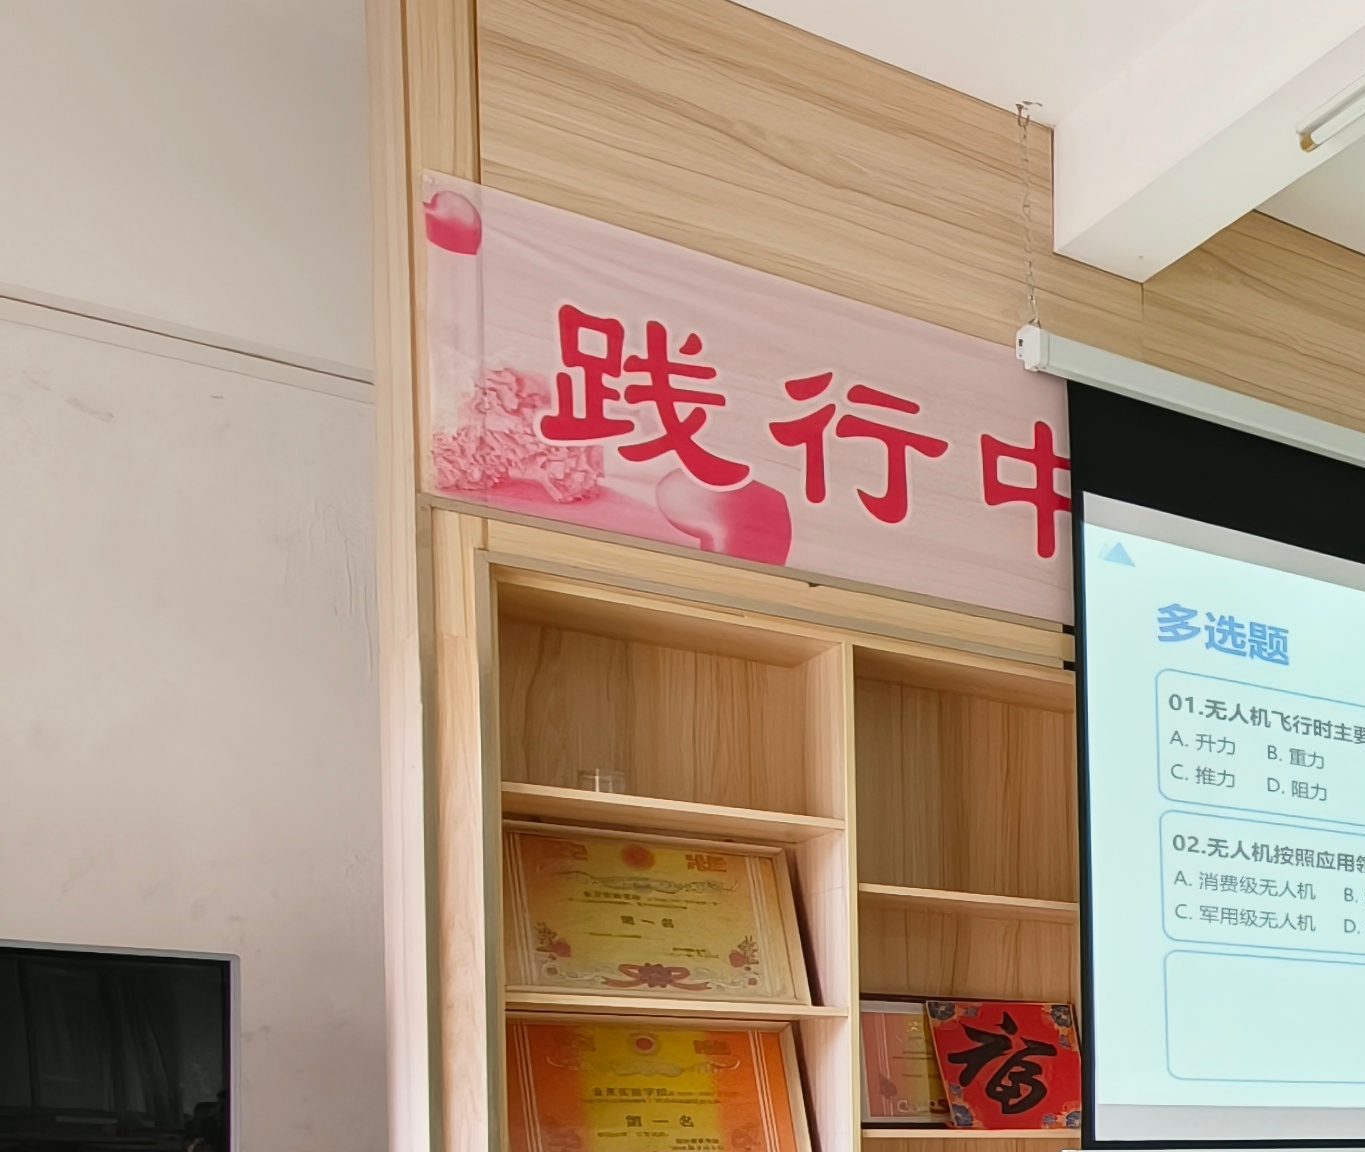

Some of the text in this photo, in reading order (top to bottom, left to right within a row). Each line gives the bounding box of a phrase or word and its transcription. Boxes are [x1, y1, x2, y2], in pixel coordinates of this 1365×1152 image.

[538, 303, 1071, 559] 践行中
[1157, 603, 1290, 665] 多选题
[1169, 730, 1326, 770] A. 升力 B. 重力
[1170, 763, 1328, 801] C. 推力 D. 阻力
[1173, 870, 1193, 887] A.
[1199, 872, 1317, 901] 消费级无人机
[1343, 887, 1359, 904] B.
[1174, 903, 1193, 921] C.
[1199, 904, 1317, 932] 军用级无人机
[1343, 919, 1361, 935] D.
[947, 1011, 1058, 1115] 福
